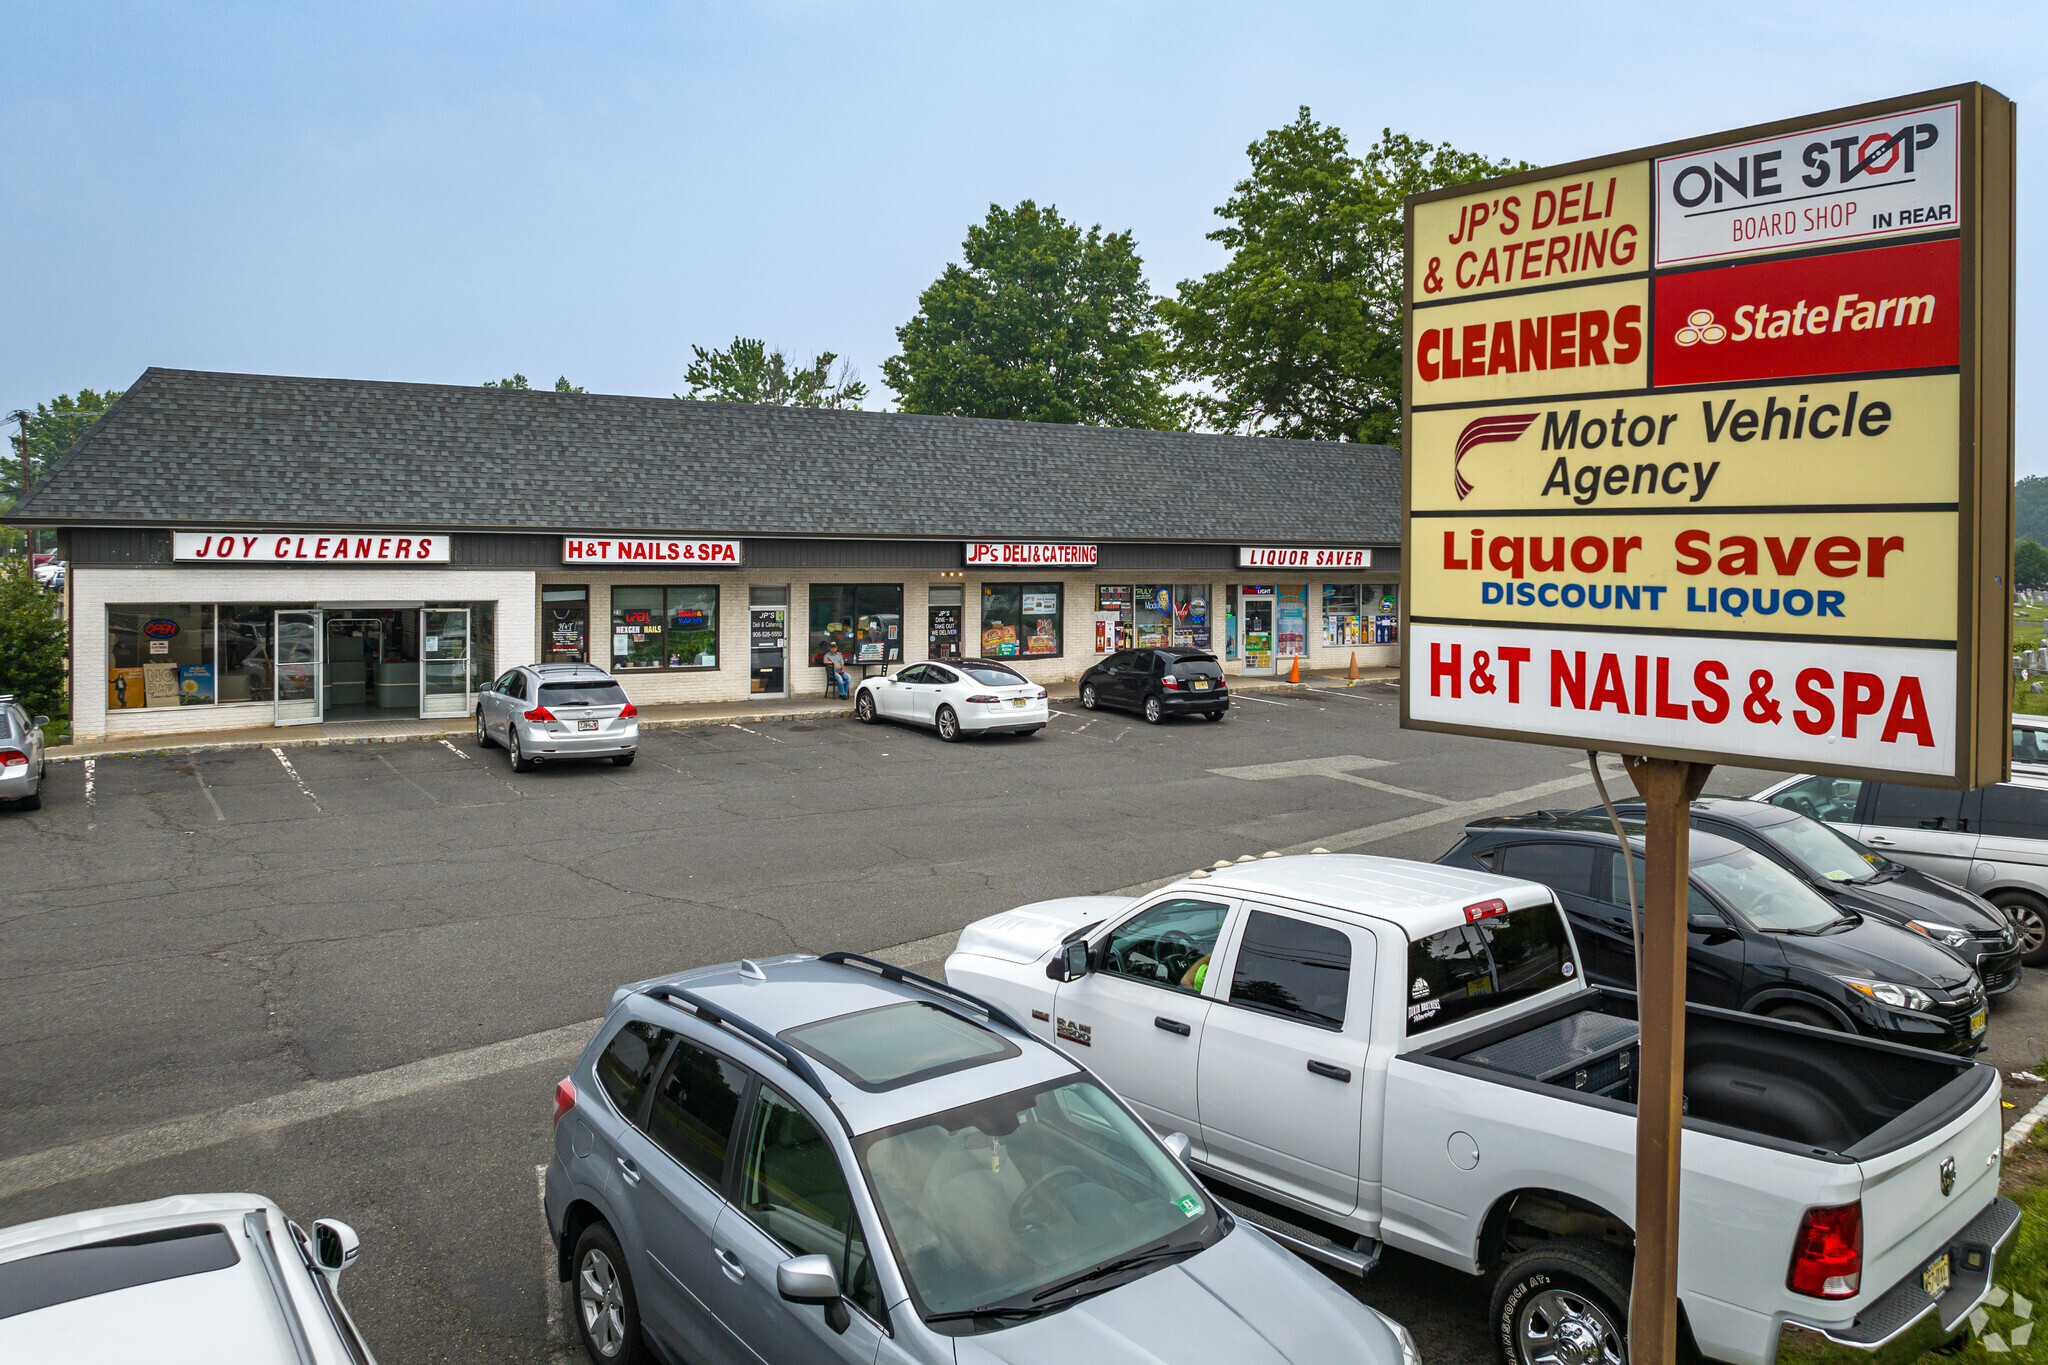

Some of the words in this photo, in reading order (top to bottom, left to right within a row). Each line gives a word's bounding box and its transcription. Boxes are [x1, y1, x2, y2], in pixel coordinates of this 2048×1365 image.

[1672, 150, 1783, 209] ONE
[1801, 122, 1939, 188] STOP
[1448, 195, 1521, 245] JP'S
[1531, 176, 1618, 231] DELI
[1733, 213, 1797, 242] BOARD
[1803, 202, 1858, 232] SHOP
[1872, 212, 1892, 229] IN
[1899, 204, 1953, 228] REAR
[1423, 257, 1444, 294] &
[1456, 223, 1638, 290] CATERING
[1730, 292, 1936, 343] StateFarm
[1416, 304, 1643, 382] CLEANERS
[1541, 409, 1678, 451] Motor
[1702, 391, 1892, 444] Vehicle
[1541, 455, 1721, 505] Agency
[196, 536, 259, 558] JOY
[275, 536, 433, 559] CLEANERS
[568, 540, 611, 559] H&T
[1249, 549, 1309, 565] LIQUOR
[1316, 550, 1363, 566] SAVER
[1443, 528, 1642, 578] Liquor
[1675, 529, 1904, 578] Saver
[1481, 581, 1668, 611] DISCOUNT
[1687, 586, 1846, 617] LIQUOR
[145, 624, 177, 634] OPEN
[643, 625, 662, 634] NAILS
[146, 668, 175, 683] NO
[1430, 642, 1531, 704] H&T
[1057, 1016, 1092, 1034] RAM
[1057, 1025, 1092, 1043] 2500
